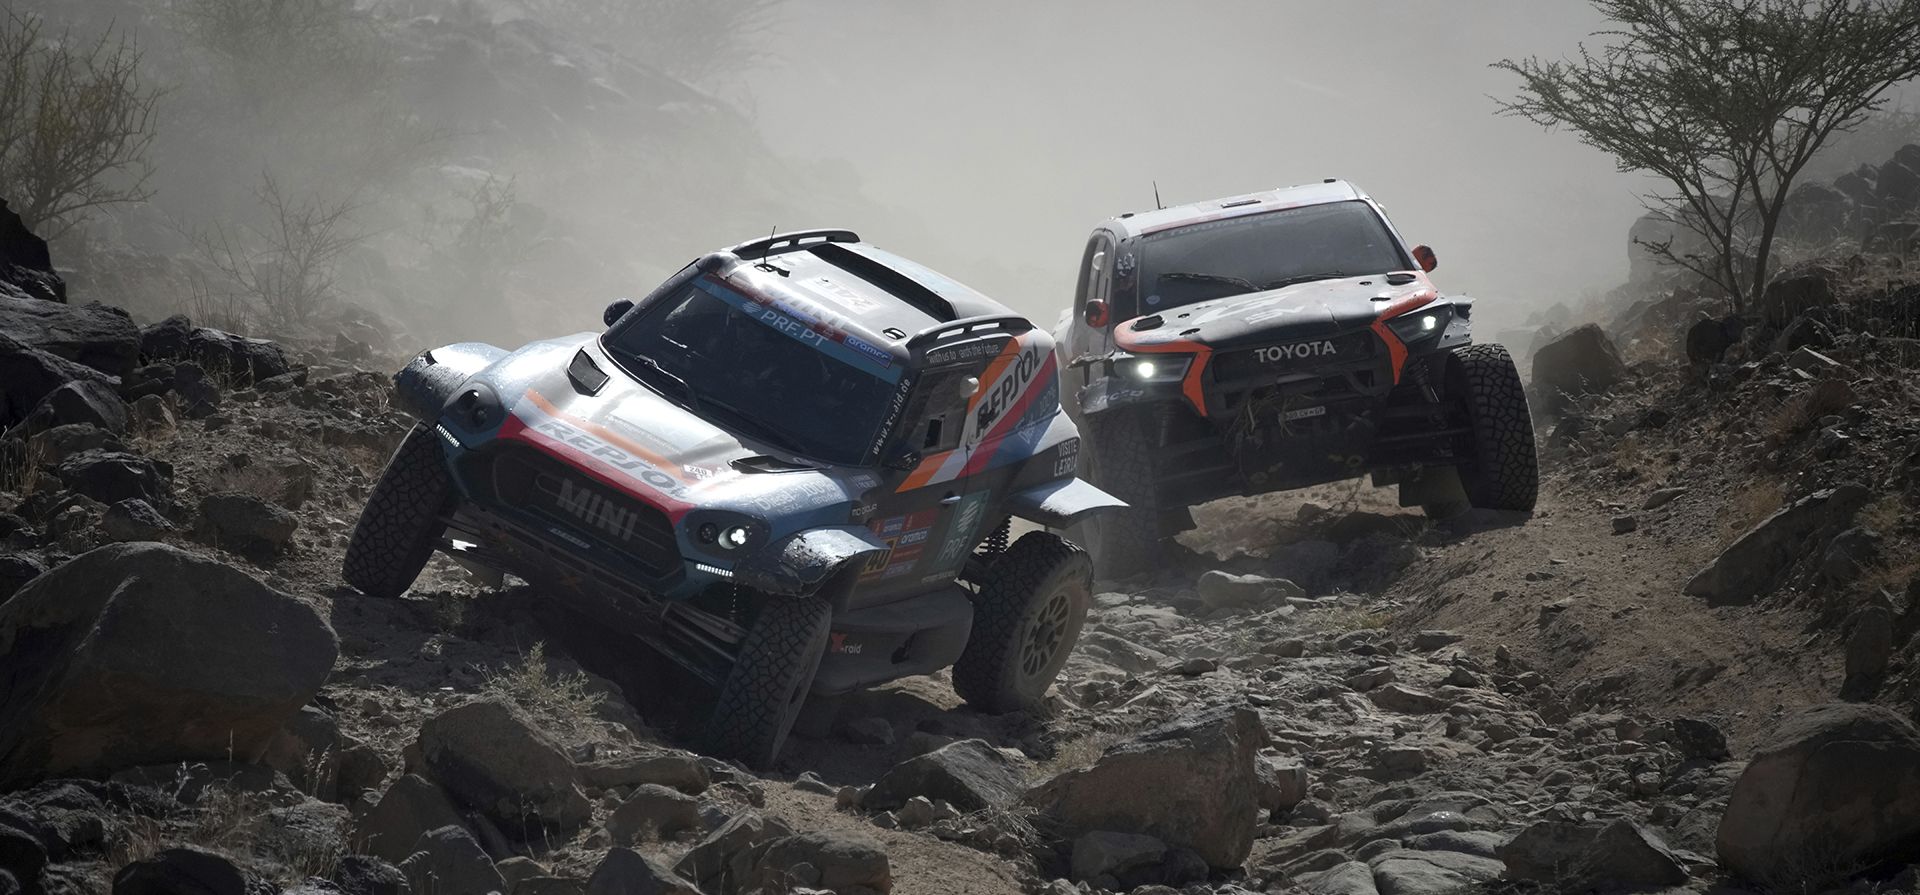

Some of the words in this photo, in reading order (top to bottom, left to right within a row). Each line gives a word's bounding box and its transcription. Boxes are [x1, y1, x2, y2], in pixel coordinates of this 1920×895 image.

[761, 311, 829, 347] PRF.PT
[1254, 340, 1337, 363] TOYOTA
[975, 344, 1041, 440] REPSOL
[1057, 438, 1078, 457] VISITE
[688, 465, 708, 476] 240
[555, 477, 639, 543] MINI
